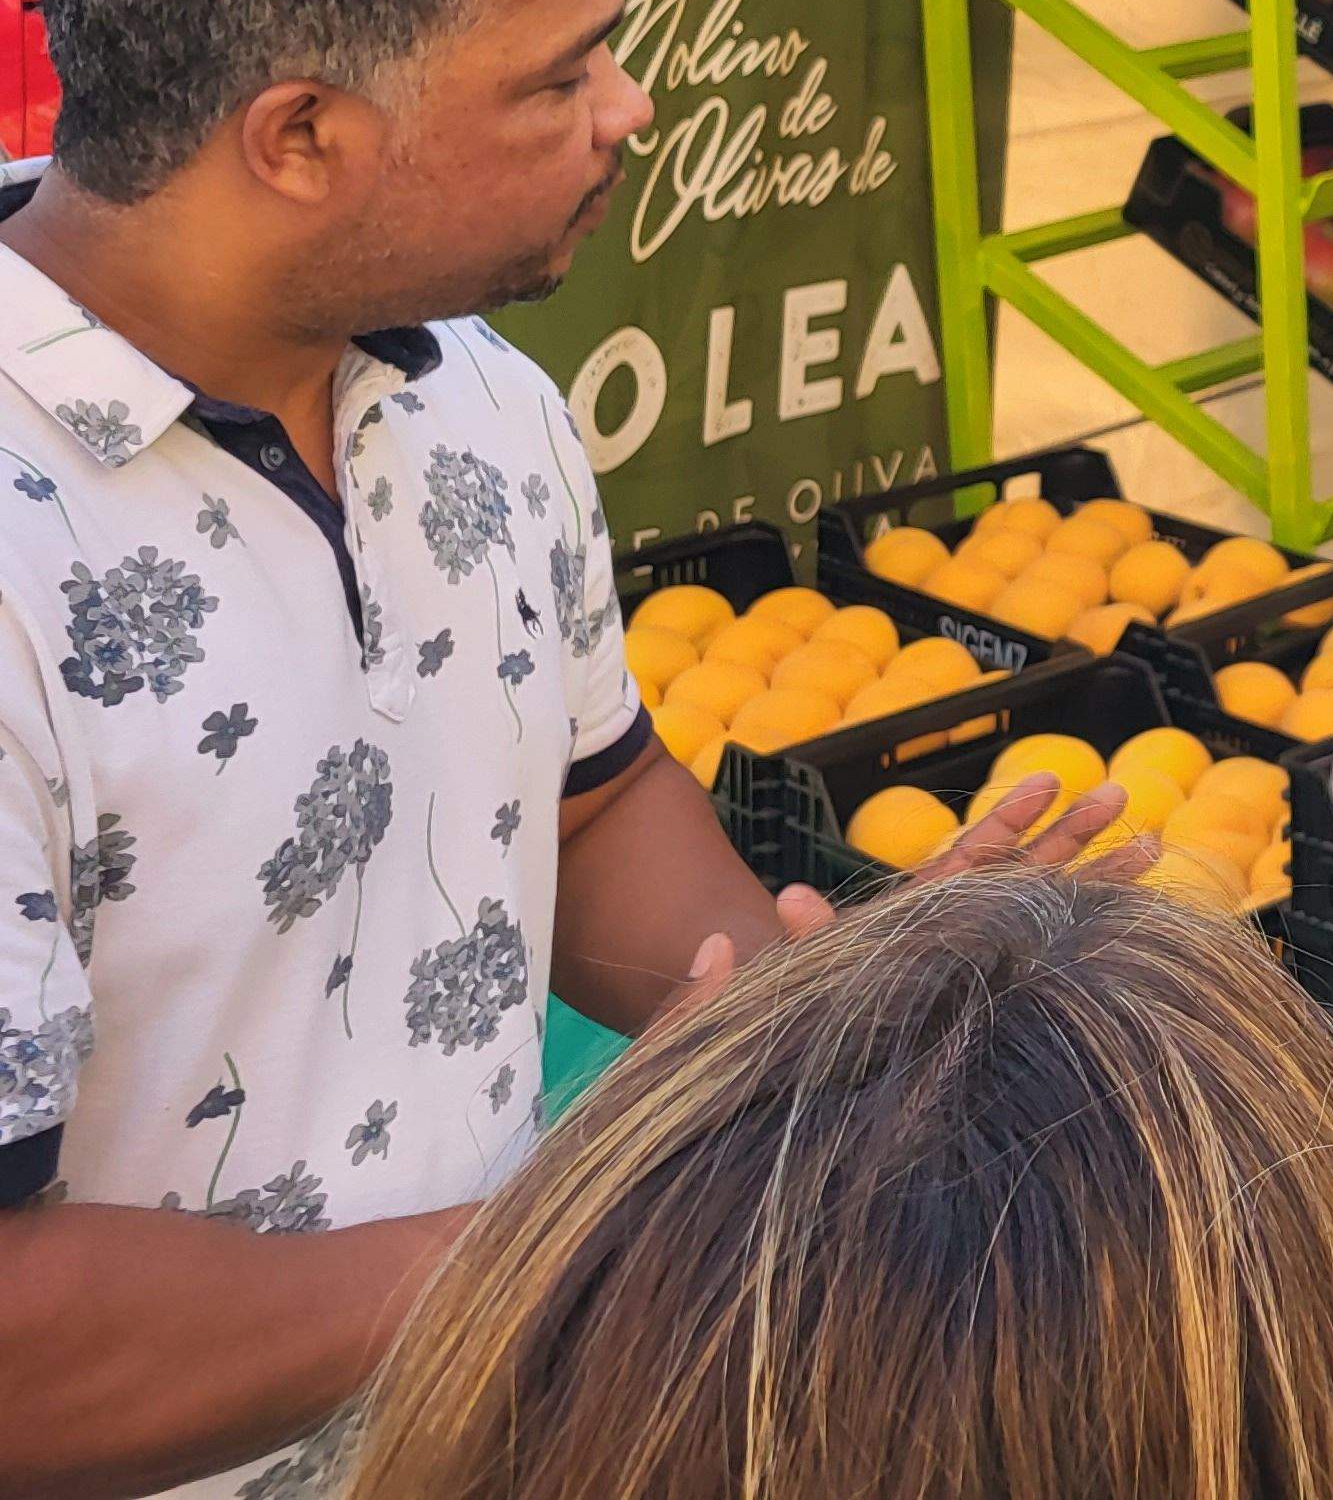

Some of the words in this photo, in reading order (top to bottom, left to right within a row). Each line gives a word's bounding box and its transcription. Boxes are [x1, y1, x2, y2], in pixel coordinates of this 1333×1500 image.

[778, 56, 839, 139] de
[630, 94, 849, 264] Olivas
[849, 114, 899, 197] de
